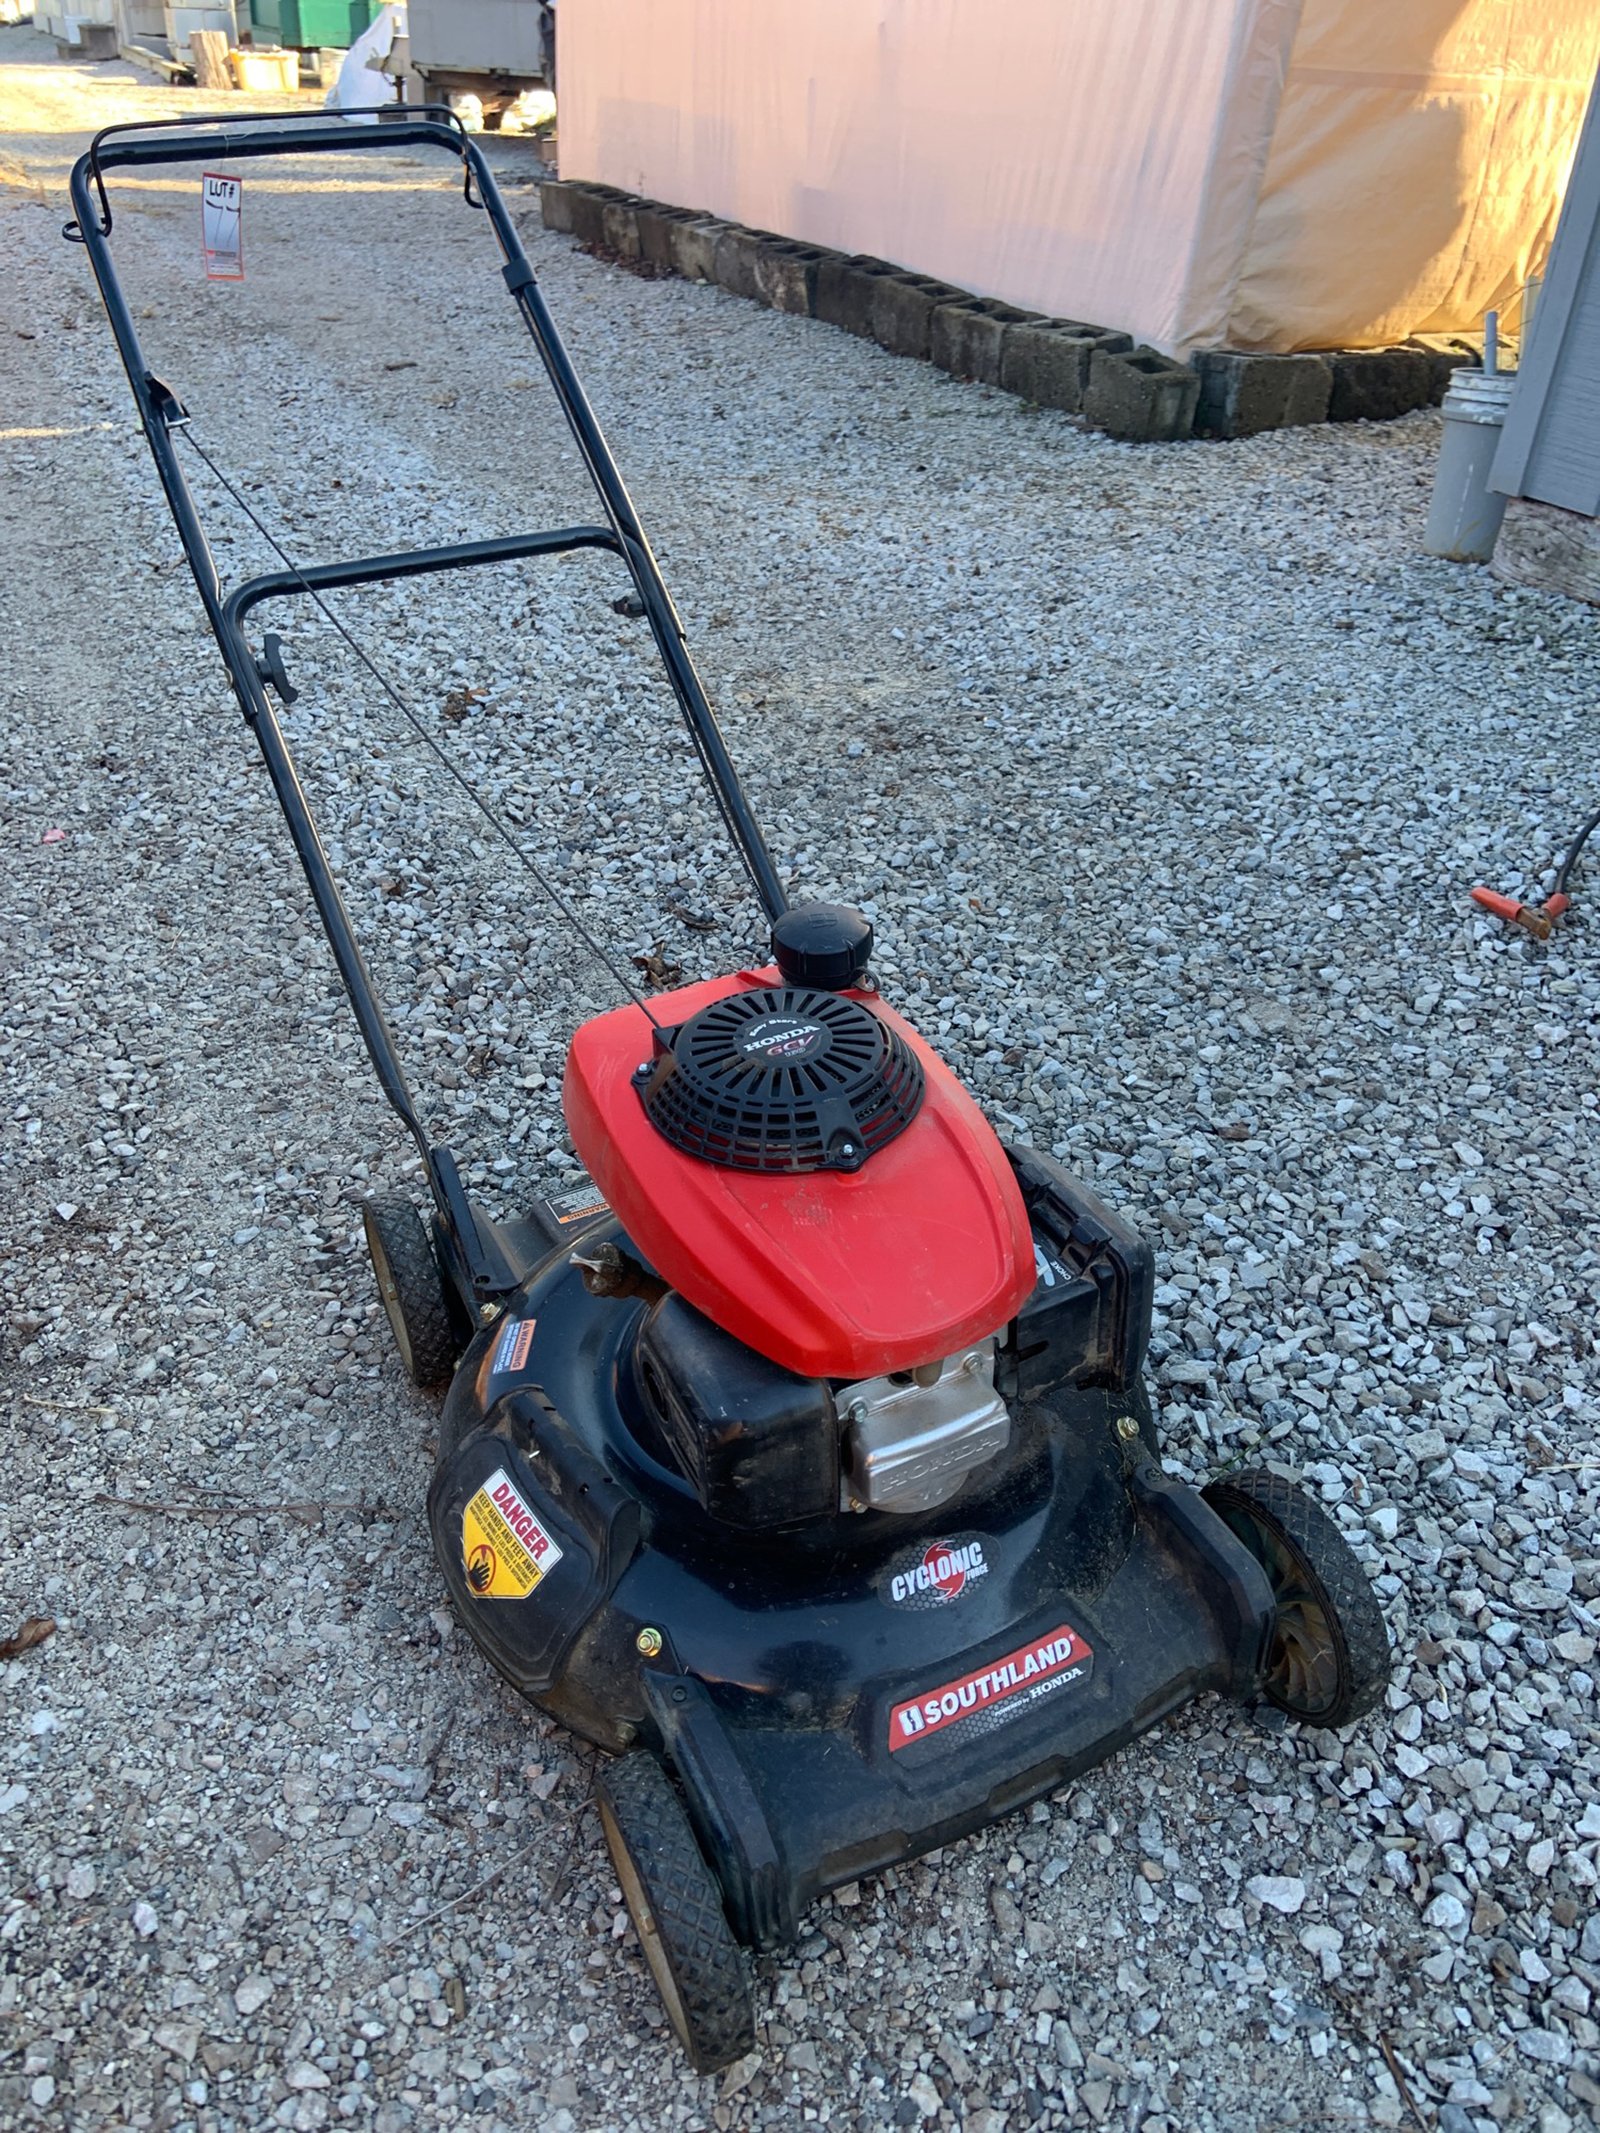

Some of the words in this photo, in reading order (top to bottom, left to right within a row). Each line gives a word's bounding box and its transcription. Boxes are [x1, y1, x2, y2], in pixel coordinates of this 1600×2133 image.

[743, 1025, 821, 1052] HONDA
[766, 1035, 815, 1056] GCV
[1050, 1260, 1072, 1281] CHOKE
[512, 1329, 529, 1368] WARNING
[881, 1438, 1000, 1493] HONDA
[478, 1492, 490, 1509] KEEP
[488, 1507, 504, 1531] HANDS
[501, 1529, 514, 1545] AND
[510, 1541, 525, 1560] FEET
[522, 1558, 539, 1578] AWAY
[491, 1482, 549, 1561] DANGER
[891, 1542, 983, 1602] CYCLONIC
[966, 1563, 989, 1581] FORCE
[924, 1637, 1073, 1725] SOUTHLAND
[1029, 1667, 1083, 1699] HONDA
